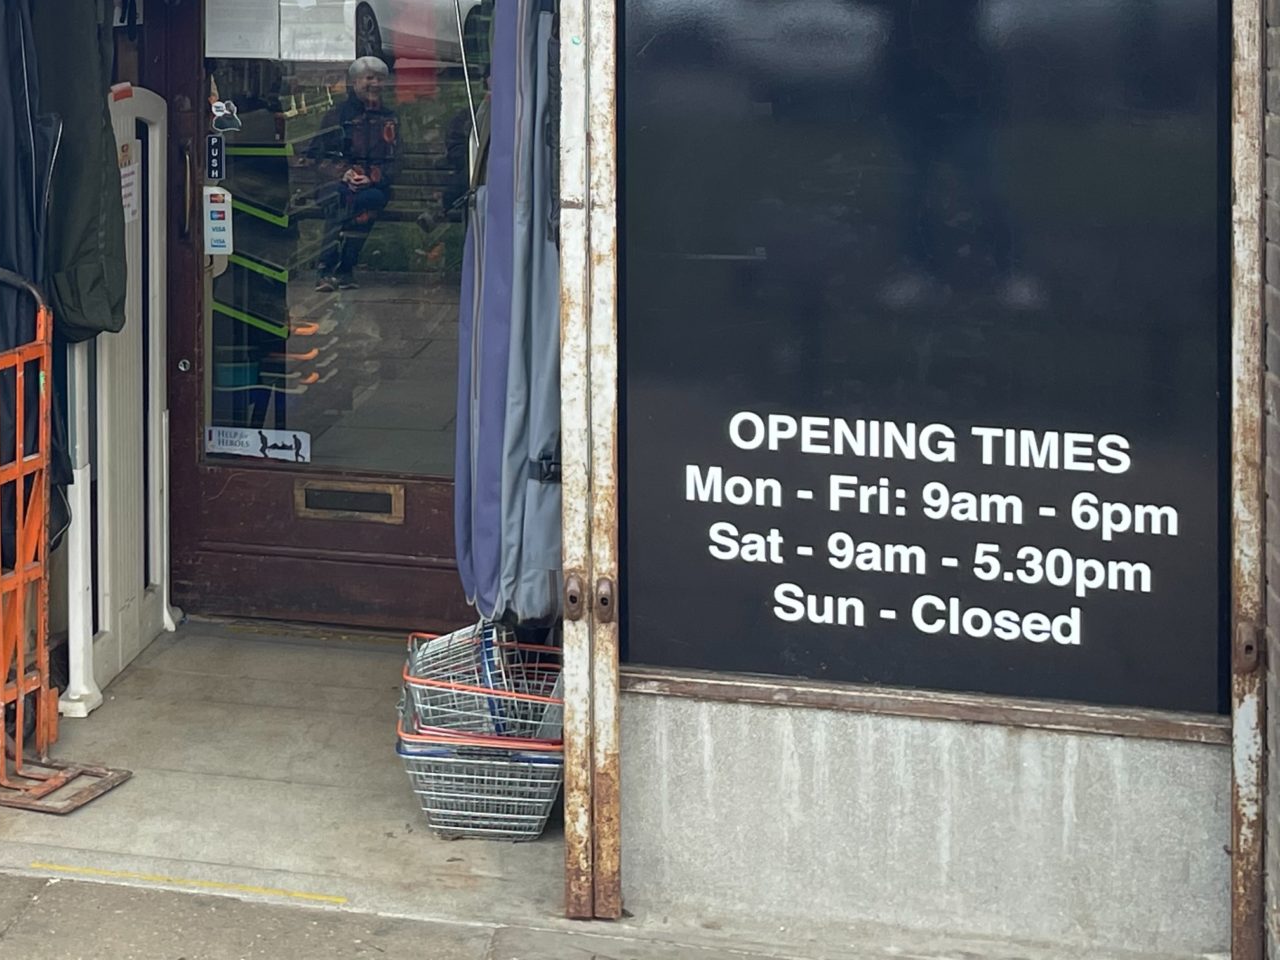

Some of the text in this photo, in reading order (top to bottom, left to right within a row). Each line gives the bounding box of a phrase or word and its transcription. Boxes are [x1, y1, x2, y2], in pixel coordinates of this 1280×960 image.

[210, 137, 219, 179] PUSH
[218, 429, 238, 438] HELP
[218, 439, 250, 448] HEROES
[729, 412, 1130, 473] OPENING TIMES
[686, 465, 1177, 541] Mon - Fri: 9am - 6pm
[709, 522, 1151, 597] Sat - 9am - 5.30pm
[774, 583, 1081, 645] Sun - Closed
